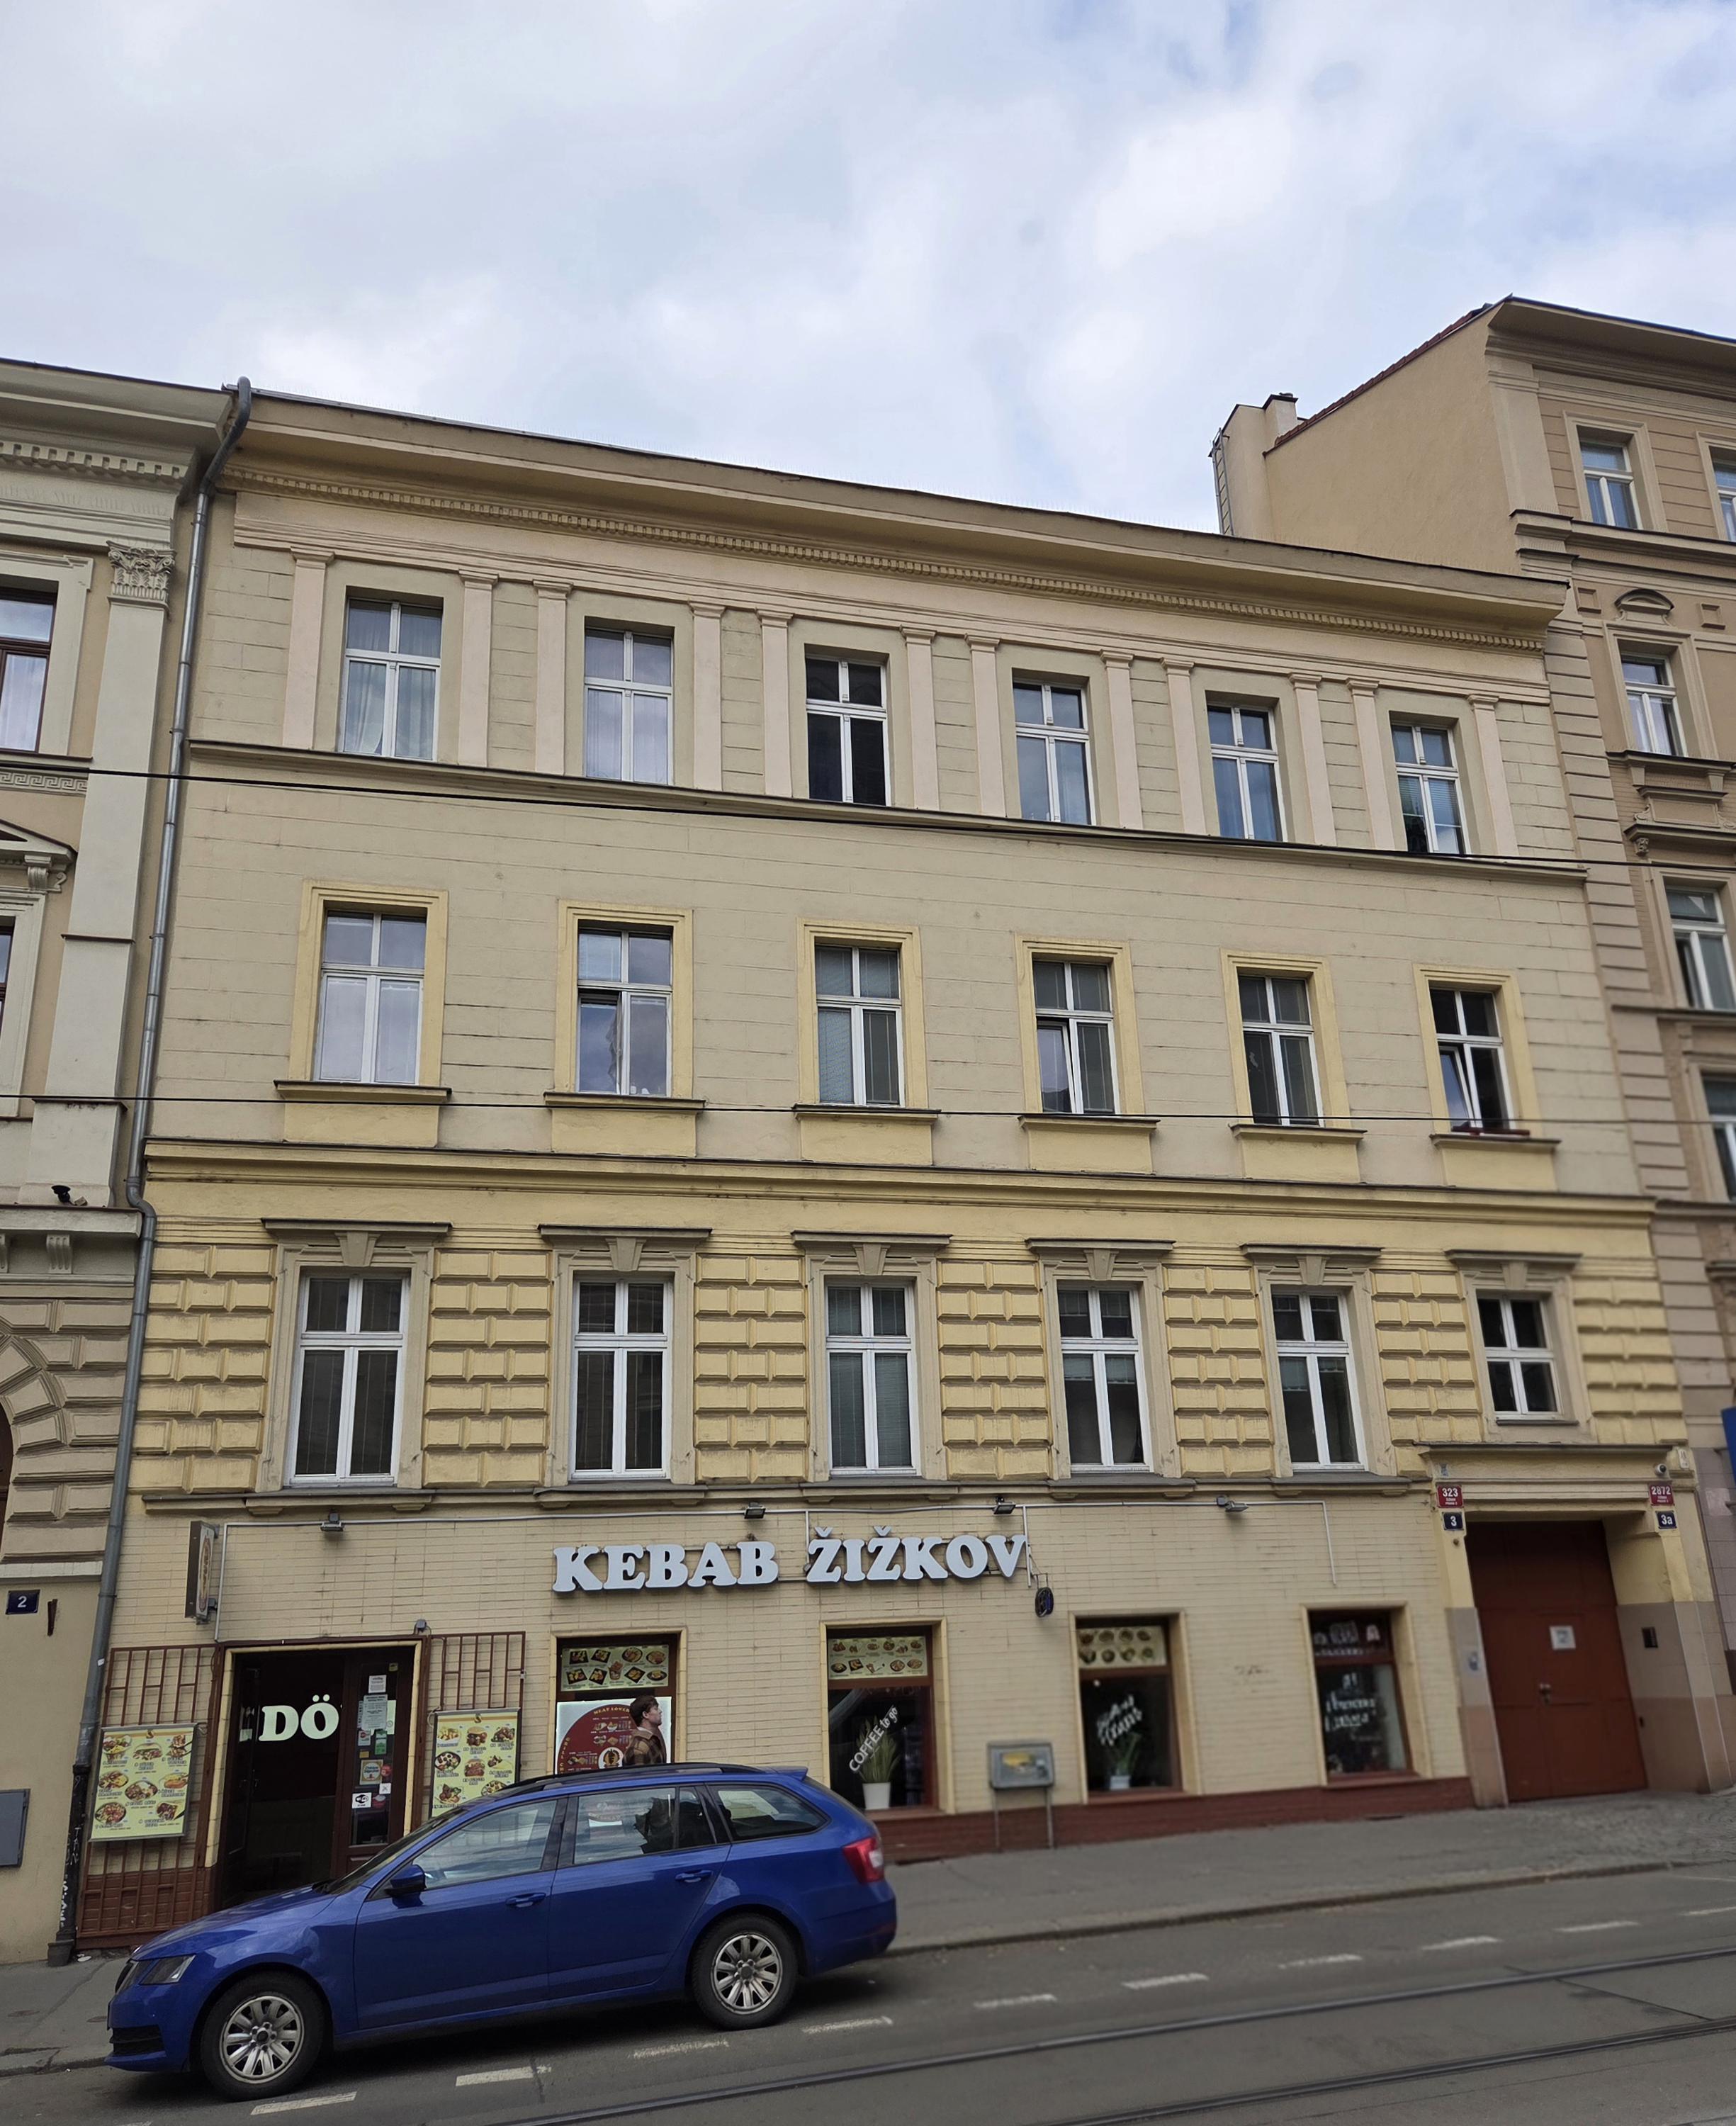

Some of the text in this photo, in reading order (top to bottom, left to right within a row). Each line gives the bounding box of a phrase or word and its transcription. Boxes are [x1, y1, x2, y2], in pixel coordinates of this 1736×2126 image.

[1442, 1487, 1458, 1497] 323
[1651, 1486, 1671, 1495] 2872
[1450, 1515, 1457, 1526] 3
[1660, 1514, 1673, 1525] 3a
[552, 1526, 1027, 1592] KEBAB ŽIŽKOV
[17, 1595, 27, 1608] 2
[259, 1694, 339, 1742] DÖ
[849, 1725, 884, 1772] COFFEE
